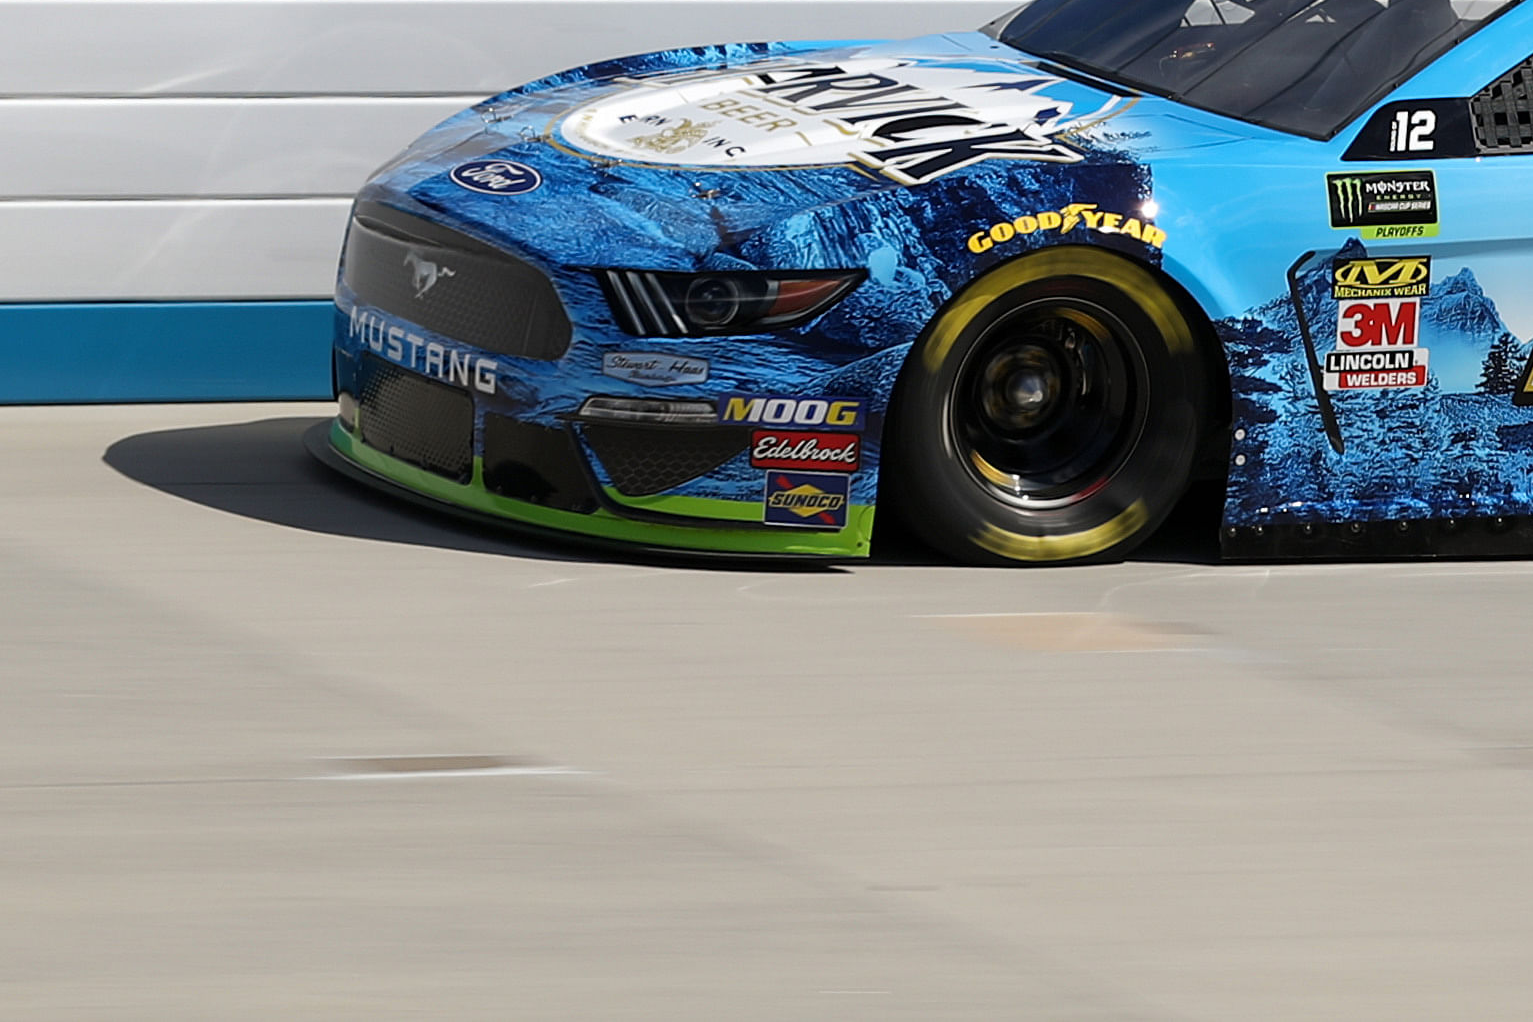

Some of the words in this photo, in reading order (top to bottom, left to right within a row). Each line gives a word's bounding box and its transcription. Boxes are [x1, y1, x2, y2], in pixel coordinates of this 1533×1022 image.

[698, 98, 798, 132] BEER
[1396, 109, 1437, 152] 12
[458, 162, 530, 191] Ford
[1365, 180, 1431, 194] MONSTER
[967, 204, 1167, 254] GOODYEAR
[1375, 226, 1424, 238] PLAYOFFS
[1334, 284, 1392, 298] MECHANIX
[1393, 283, 1427, 297] WEAR
[1340, 302, 1417, 347] 3M
[349, 305, 498, 395] MUSTANG
[1330, 352, 1410, 371] LINCOLN
[1346, 370, 1417, 387] WELDERS
[723, 397, 860, 426] MOOG
[753, 436, 856, 464] Edelbrock
[770, 493, 844, 510] SUNOCO
